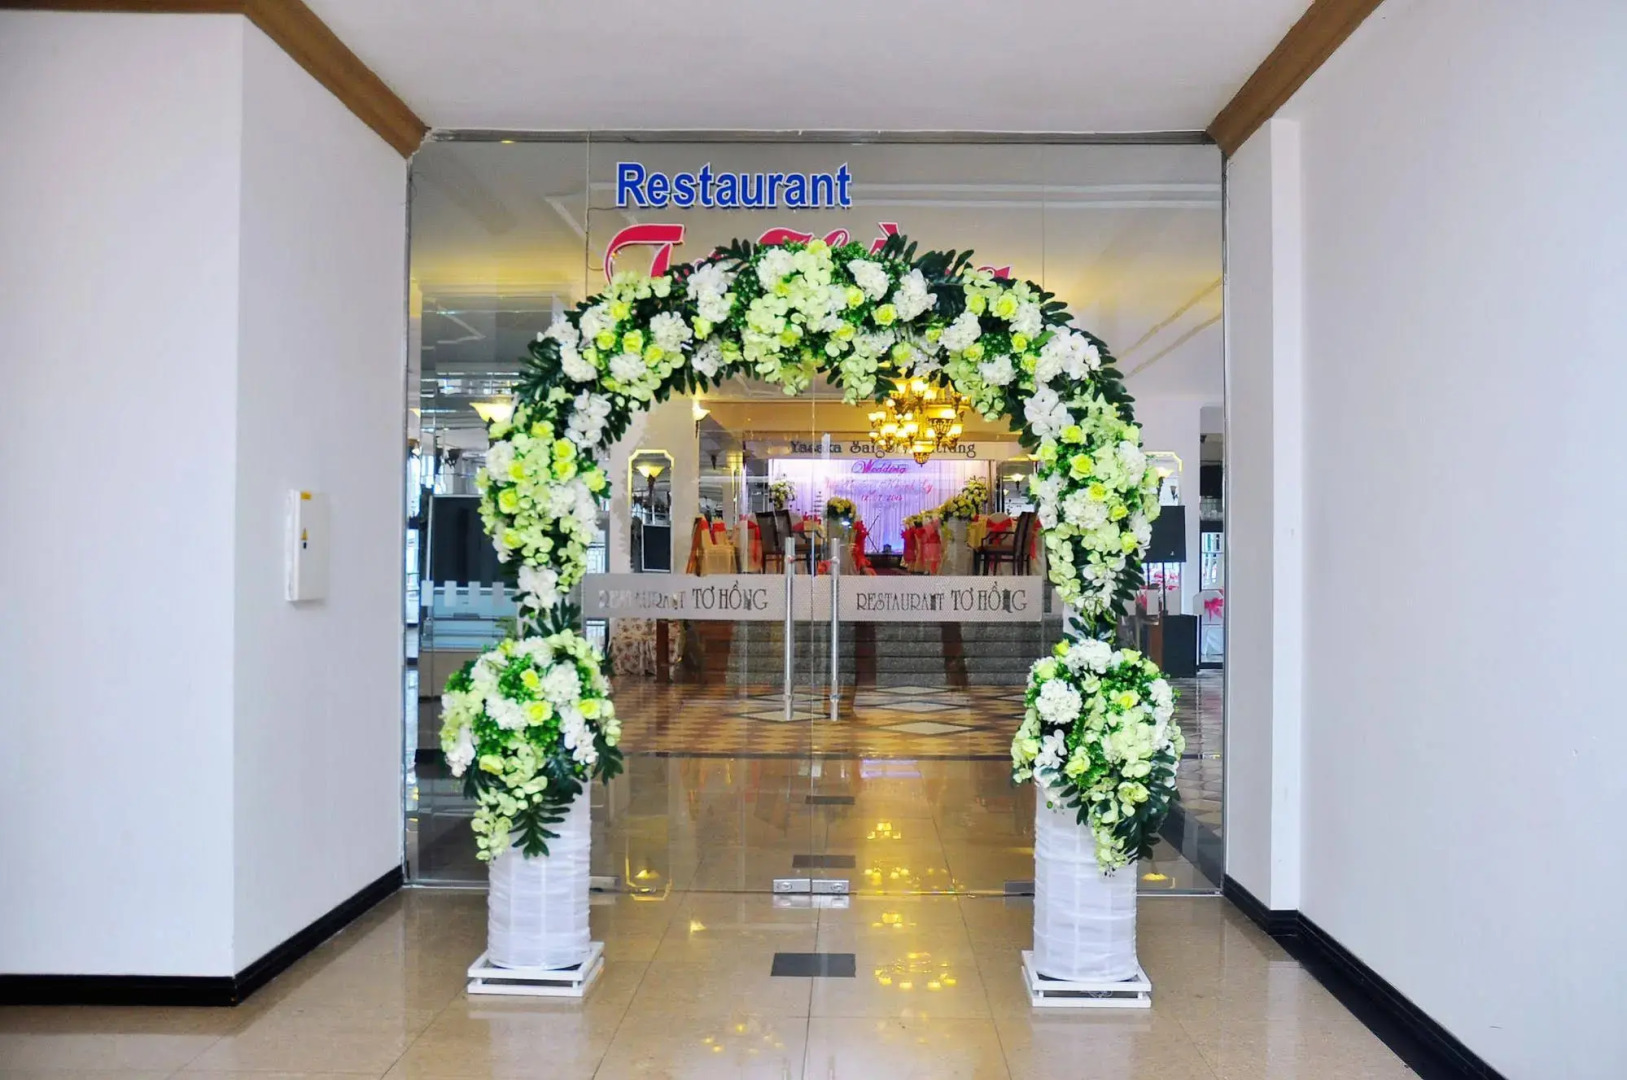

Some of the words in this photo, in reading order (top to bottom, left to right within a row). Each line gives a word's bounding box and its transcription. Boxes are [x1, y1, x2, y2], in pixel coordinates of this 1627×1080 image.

[616, 161, 852, 208] Restaurant
[851, 459, 909, 474] Wedding
[856, 592, 945, 611] RESTAURANT
